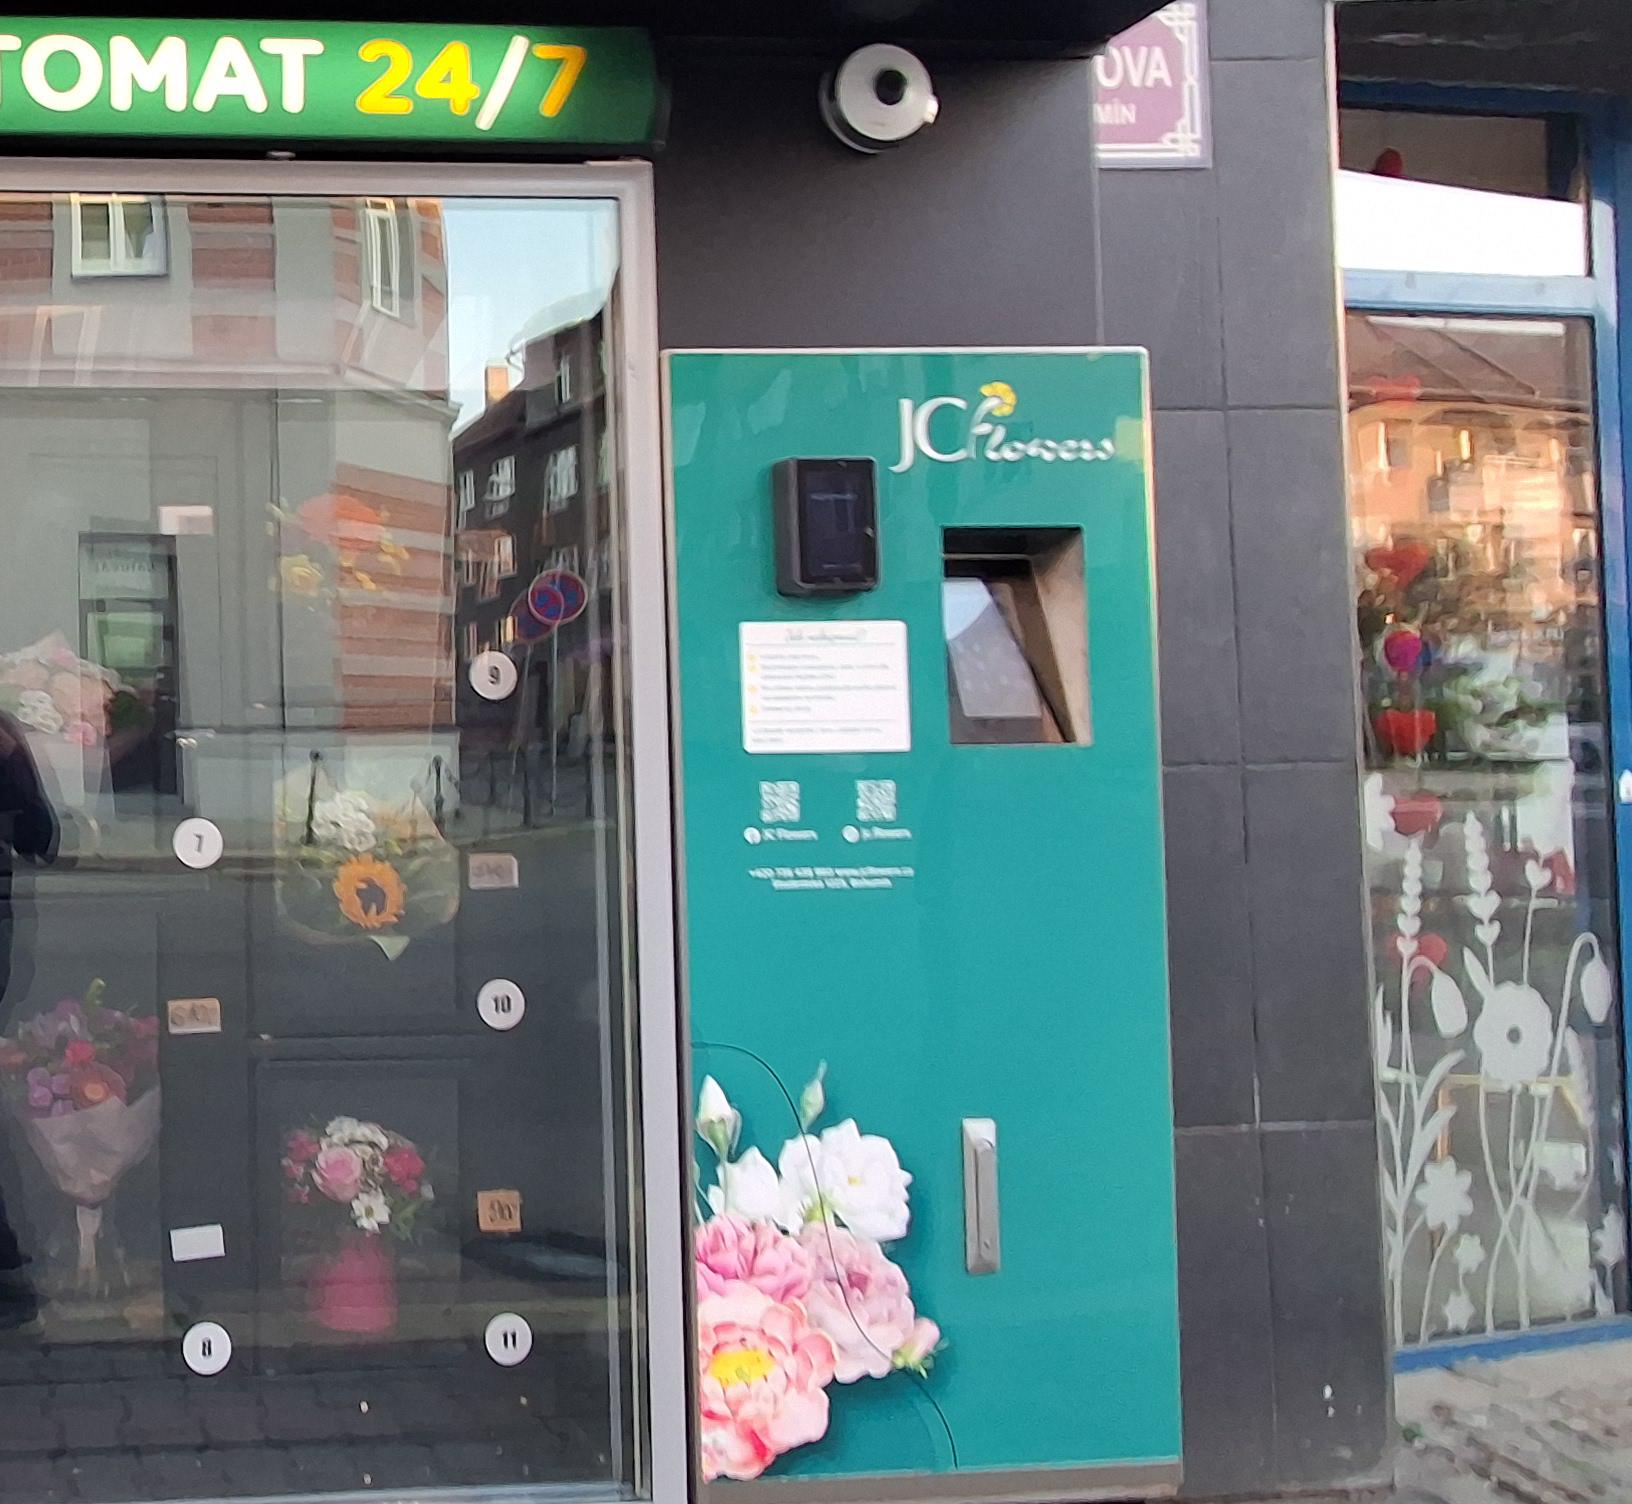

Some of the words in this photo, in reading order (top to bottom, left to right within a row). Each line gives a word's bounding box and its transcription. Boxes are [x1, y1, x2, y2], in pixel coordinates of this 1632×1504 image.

[355, 35, 588, 130] 24/7
[488, 665, 501, 685] 9
[492, 995, 511, 1015] 10
[500, 1331, 516, 1350] 11
